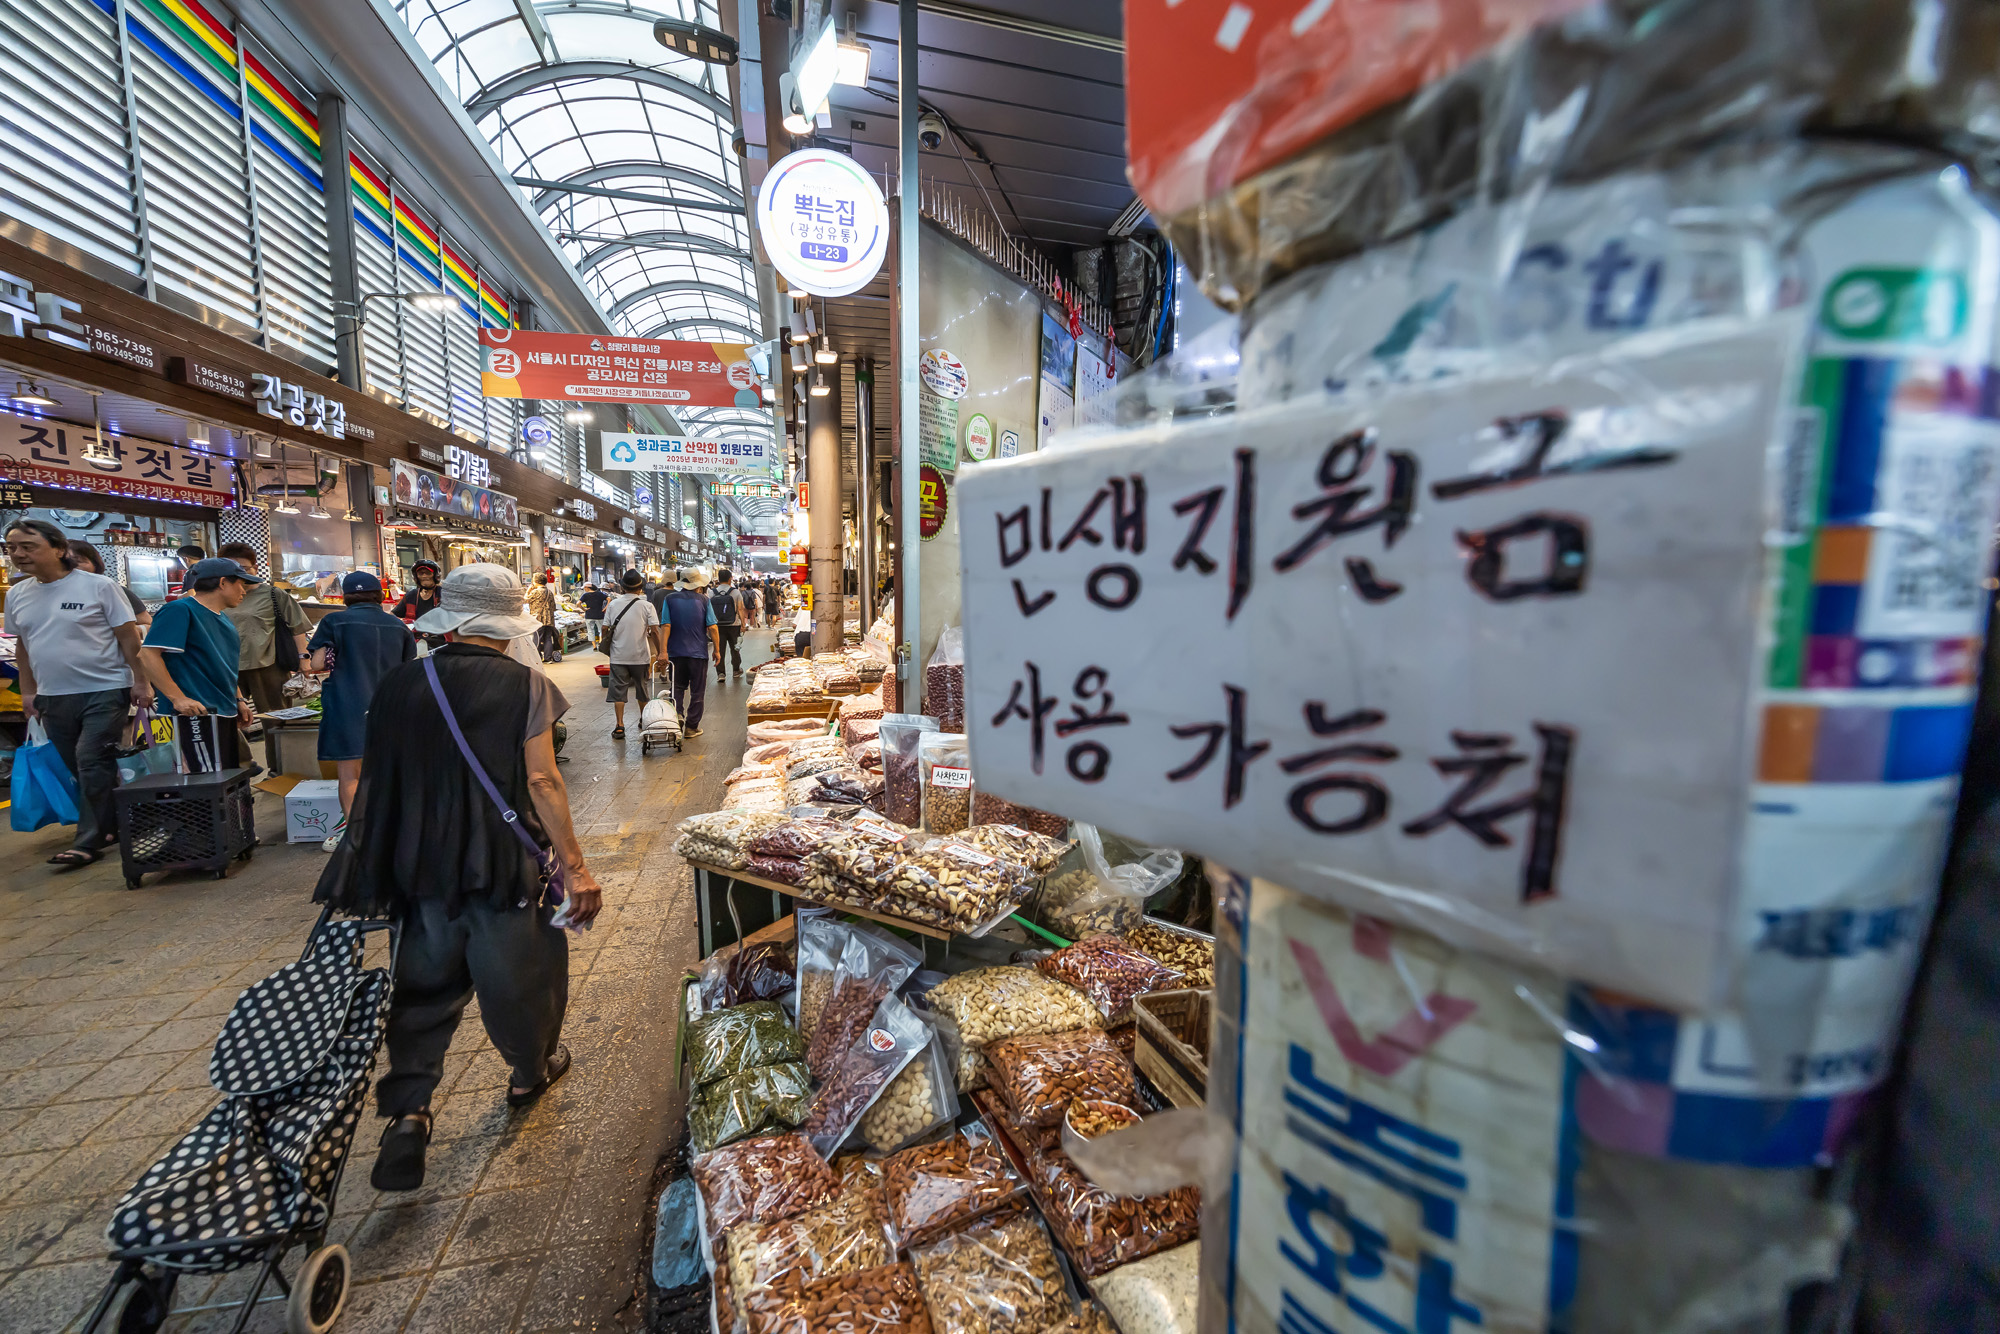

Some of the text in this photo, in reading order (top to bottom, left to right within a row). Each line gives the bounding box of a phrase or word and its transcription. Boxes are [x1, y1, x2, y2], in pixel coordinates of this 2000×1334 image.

[790, 221, 858, 244] (광성유통)
[808, 244, 840, 260] 나-23
[493, 353, 516, 373] 경
[526, 352, 722, 374] 서울시 디자인 혁신 전통시장 조성
[587, 368, 668, 384] 공모사업 선정
[732, 366, 750, 385] 축
[253, 373, 346, 440] 진광젓갈
[636, 438, 763, 457] 청과금고 산악회 회원모집
[666, 455, 691, 463] 2025년
[60, 602, 85, 610] NAVY
[991, 659, 1130, 784] 사용
[936, 770, 968, 781] 사차인지
